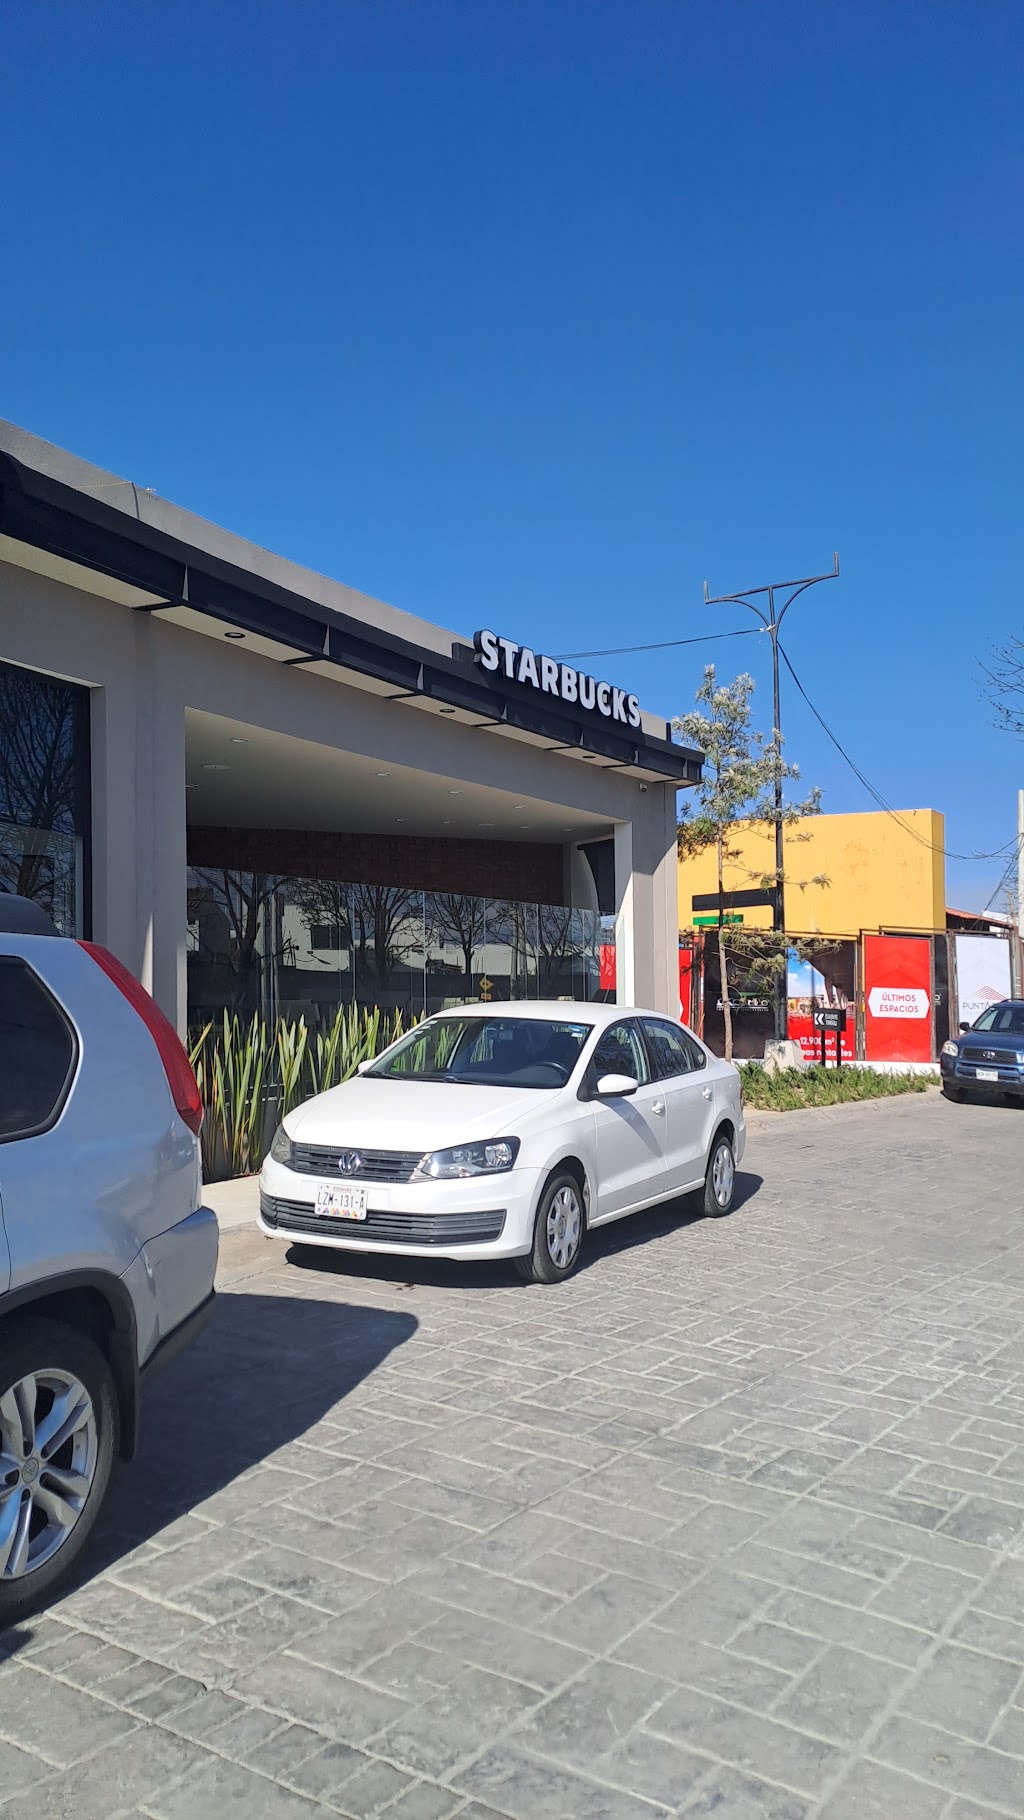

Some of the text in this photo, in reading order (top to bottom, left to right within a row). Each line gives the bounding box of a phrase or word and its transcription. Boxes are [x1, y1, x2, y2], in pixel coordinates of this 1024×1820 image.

[477, 628, 642, 728] STARBUCKS
[881, 991, 917, 1002] ÚLTIMOS
[879, 1004, 919, 1013] ESPACIOS
[816, 1048, 852, 1056] rntales
